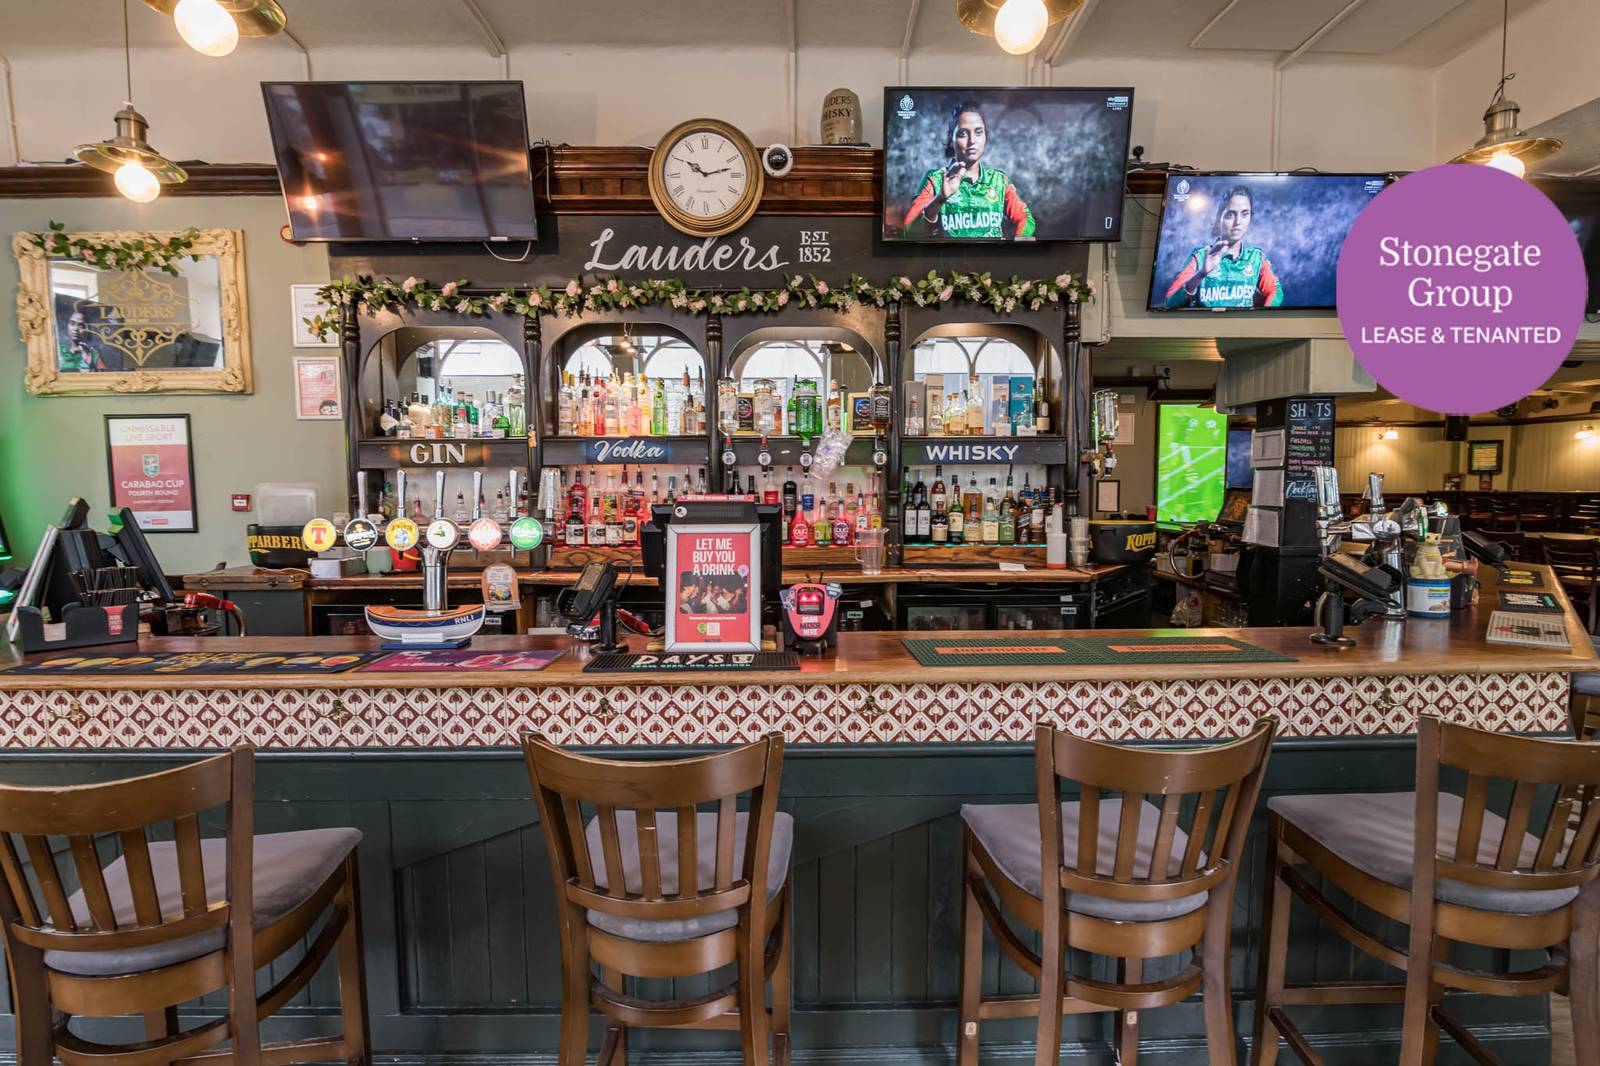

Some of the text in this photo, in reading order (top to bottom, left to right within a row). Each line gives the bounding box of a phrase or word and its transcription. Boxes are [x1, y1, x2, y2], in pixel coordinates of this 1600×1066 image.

[941, 212, 1003, 230] BANGLADES
[800, 231, 829, 245] EST
[584, 228, 789, 271] Lauders
[799, 247, 831, 263] 1852
[1200, 285, 1256, 302] BANGLADES
[1290, 402, 1332, 418] SHTS
[410, 443, 466, 464] GIN
[594, 440, 664, 462] Vodka
[926, 445, 1019, 460] WHISKY
[121, 479, 184, 488] CARABAO CUP
[311, 527, 326, 544] T
[696, 538, 732, 550] LET ME
[693, 551, 735, 562] BUY YOU
[693, 564, 735, 575] A DRINK
[454, 614, 474, 624] RNLI
[634, 654, 724, 665] DAYS
